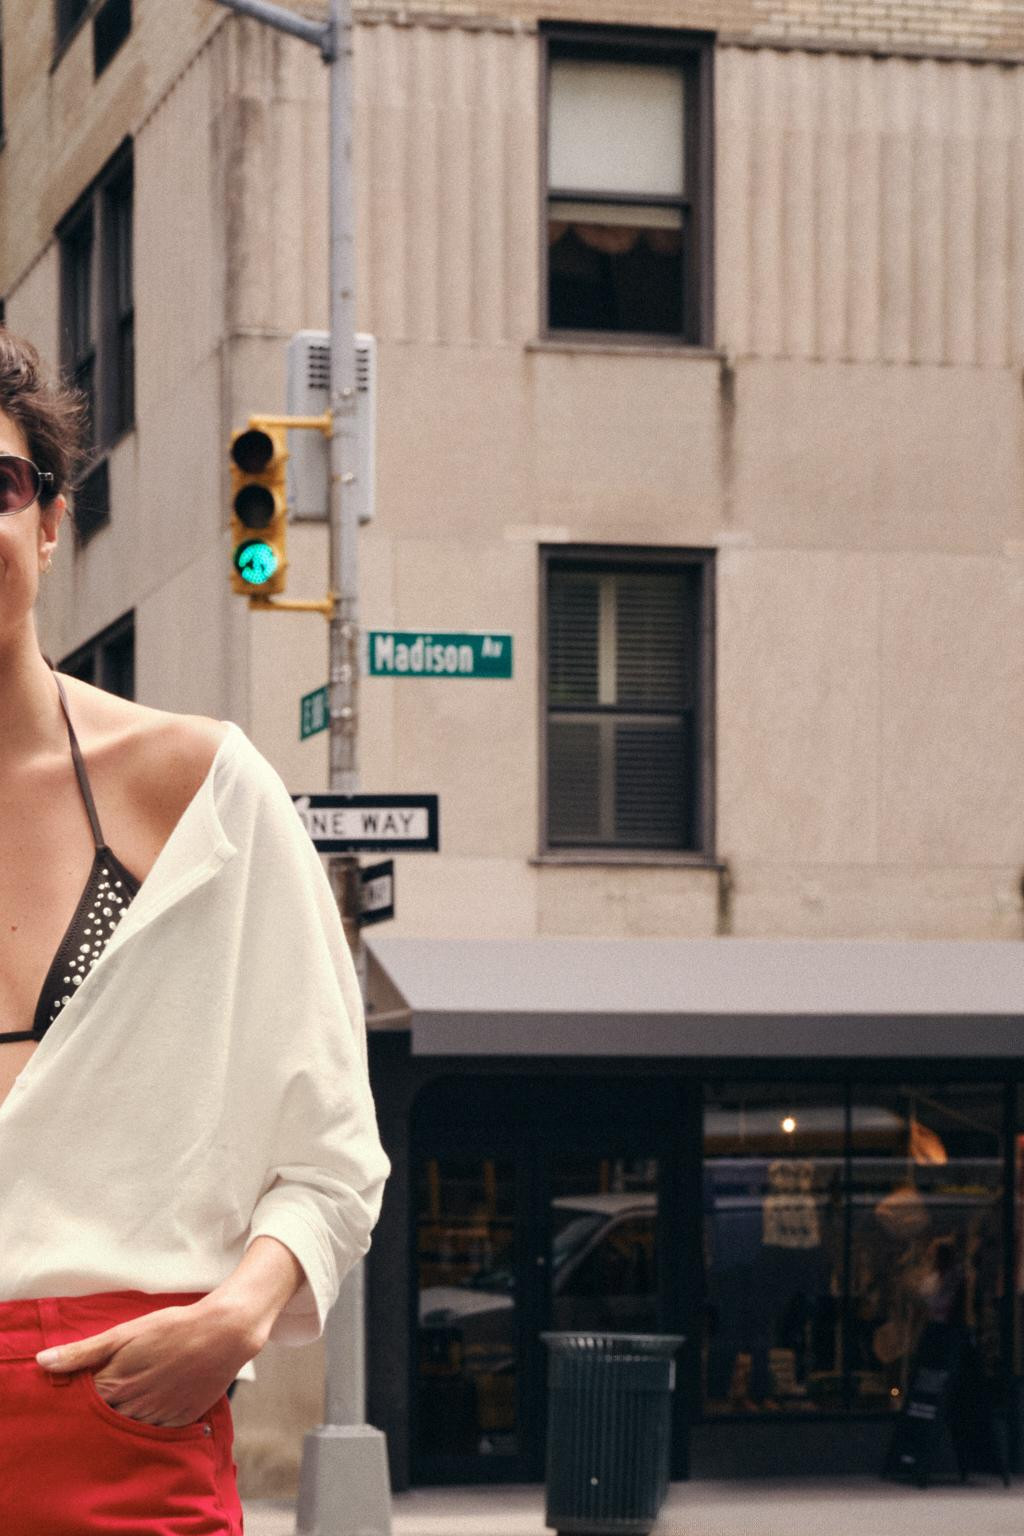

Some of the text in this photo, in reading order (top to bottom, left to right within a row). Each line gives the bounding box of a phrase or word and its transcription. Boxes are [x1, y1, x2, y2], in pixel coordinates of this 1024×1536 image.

[374, 634, 504, 673] Madison Av
[360, 812, 415, 835] WAY
